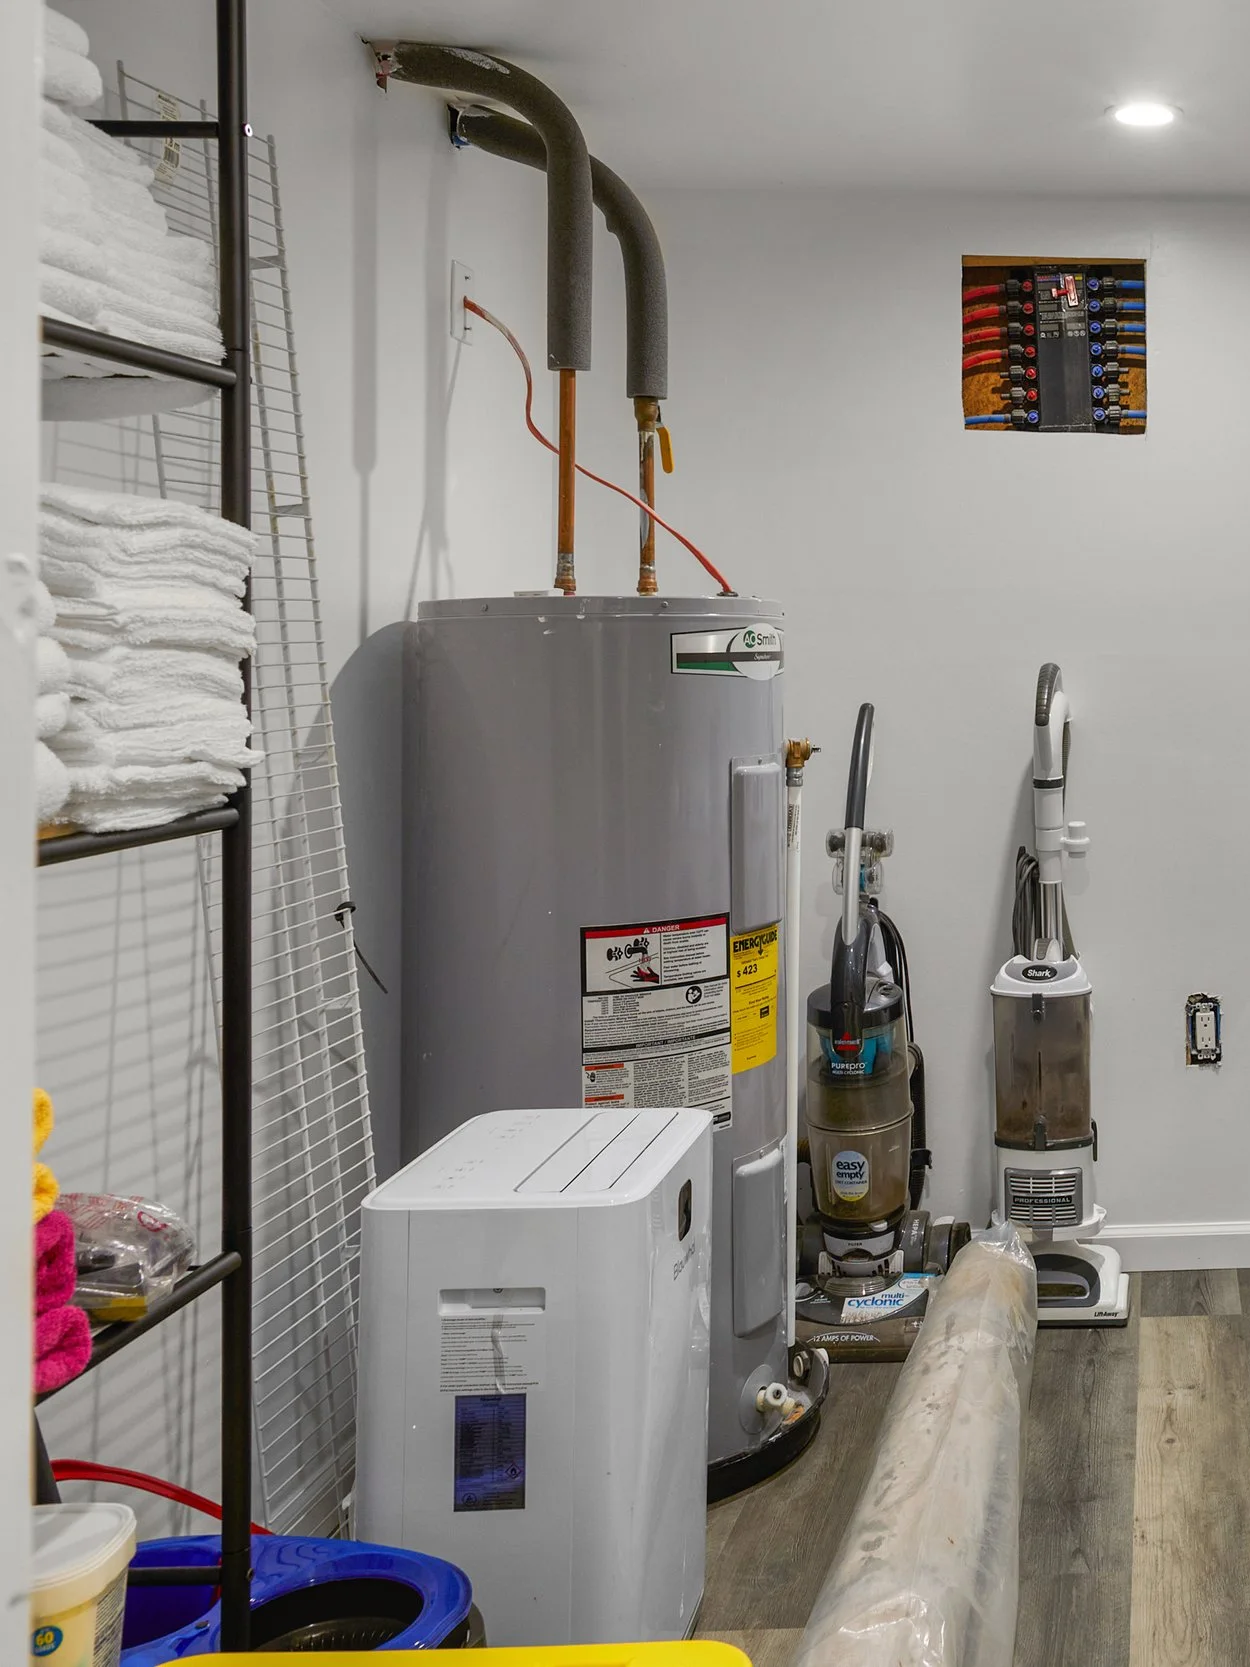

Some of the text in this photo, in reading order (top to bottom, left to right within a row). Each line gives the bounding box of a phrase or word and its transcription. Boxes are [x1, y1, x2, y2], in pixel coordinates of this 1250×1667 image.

[652, 925, 680, 933] DANGER
[743, 964, 758, 976] 423
[1027, 969, 1051, 977] Shark
[836, 1160, 865, 1172] easy
[836, 1171, 865, 1180] empty
[911, 1218, 919, 1236] HEPA
[847, 1298, 904, 1308] cyclonic
[36, 1631, 54, 1646] 60
